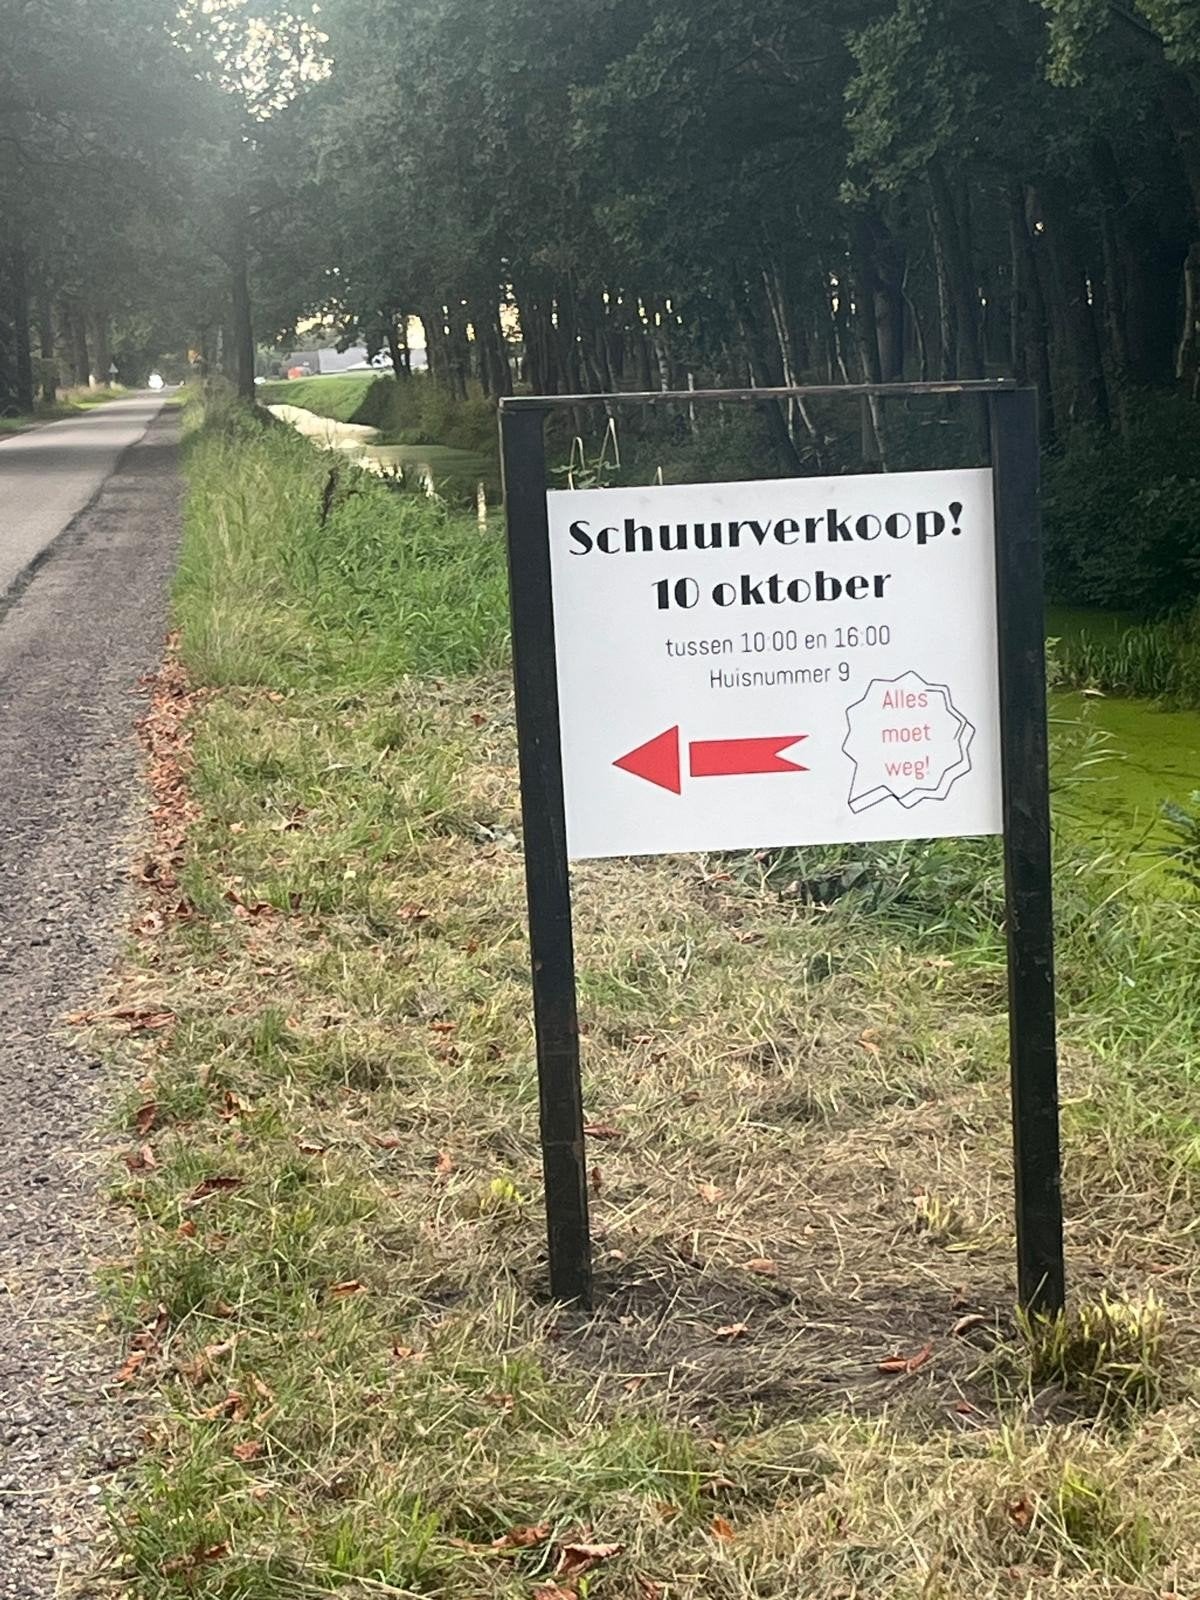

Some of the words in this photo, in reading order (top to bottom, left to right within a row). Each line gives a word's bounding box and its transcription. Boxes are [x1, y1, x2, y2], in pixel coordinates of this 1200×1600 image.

[569, 501, 964, 556] Schuurverkoop!
[651, 577, 700, 610] 10
[711, 570, 892, 607] oktober
[665, 639, 733, 657] tussen
[741, 631, 797, 653] 10:00
[804, 633, 827, 650] en
[834, 625, 890, 648] 16:00
[710, 667, 831, 689] Huisnummer
[838, 663, 850, 682] 9
[881, 690, 928, 709] Alles
[881, 724, 931, 743] moet
[884, 754, 930, 779] weg!
